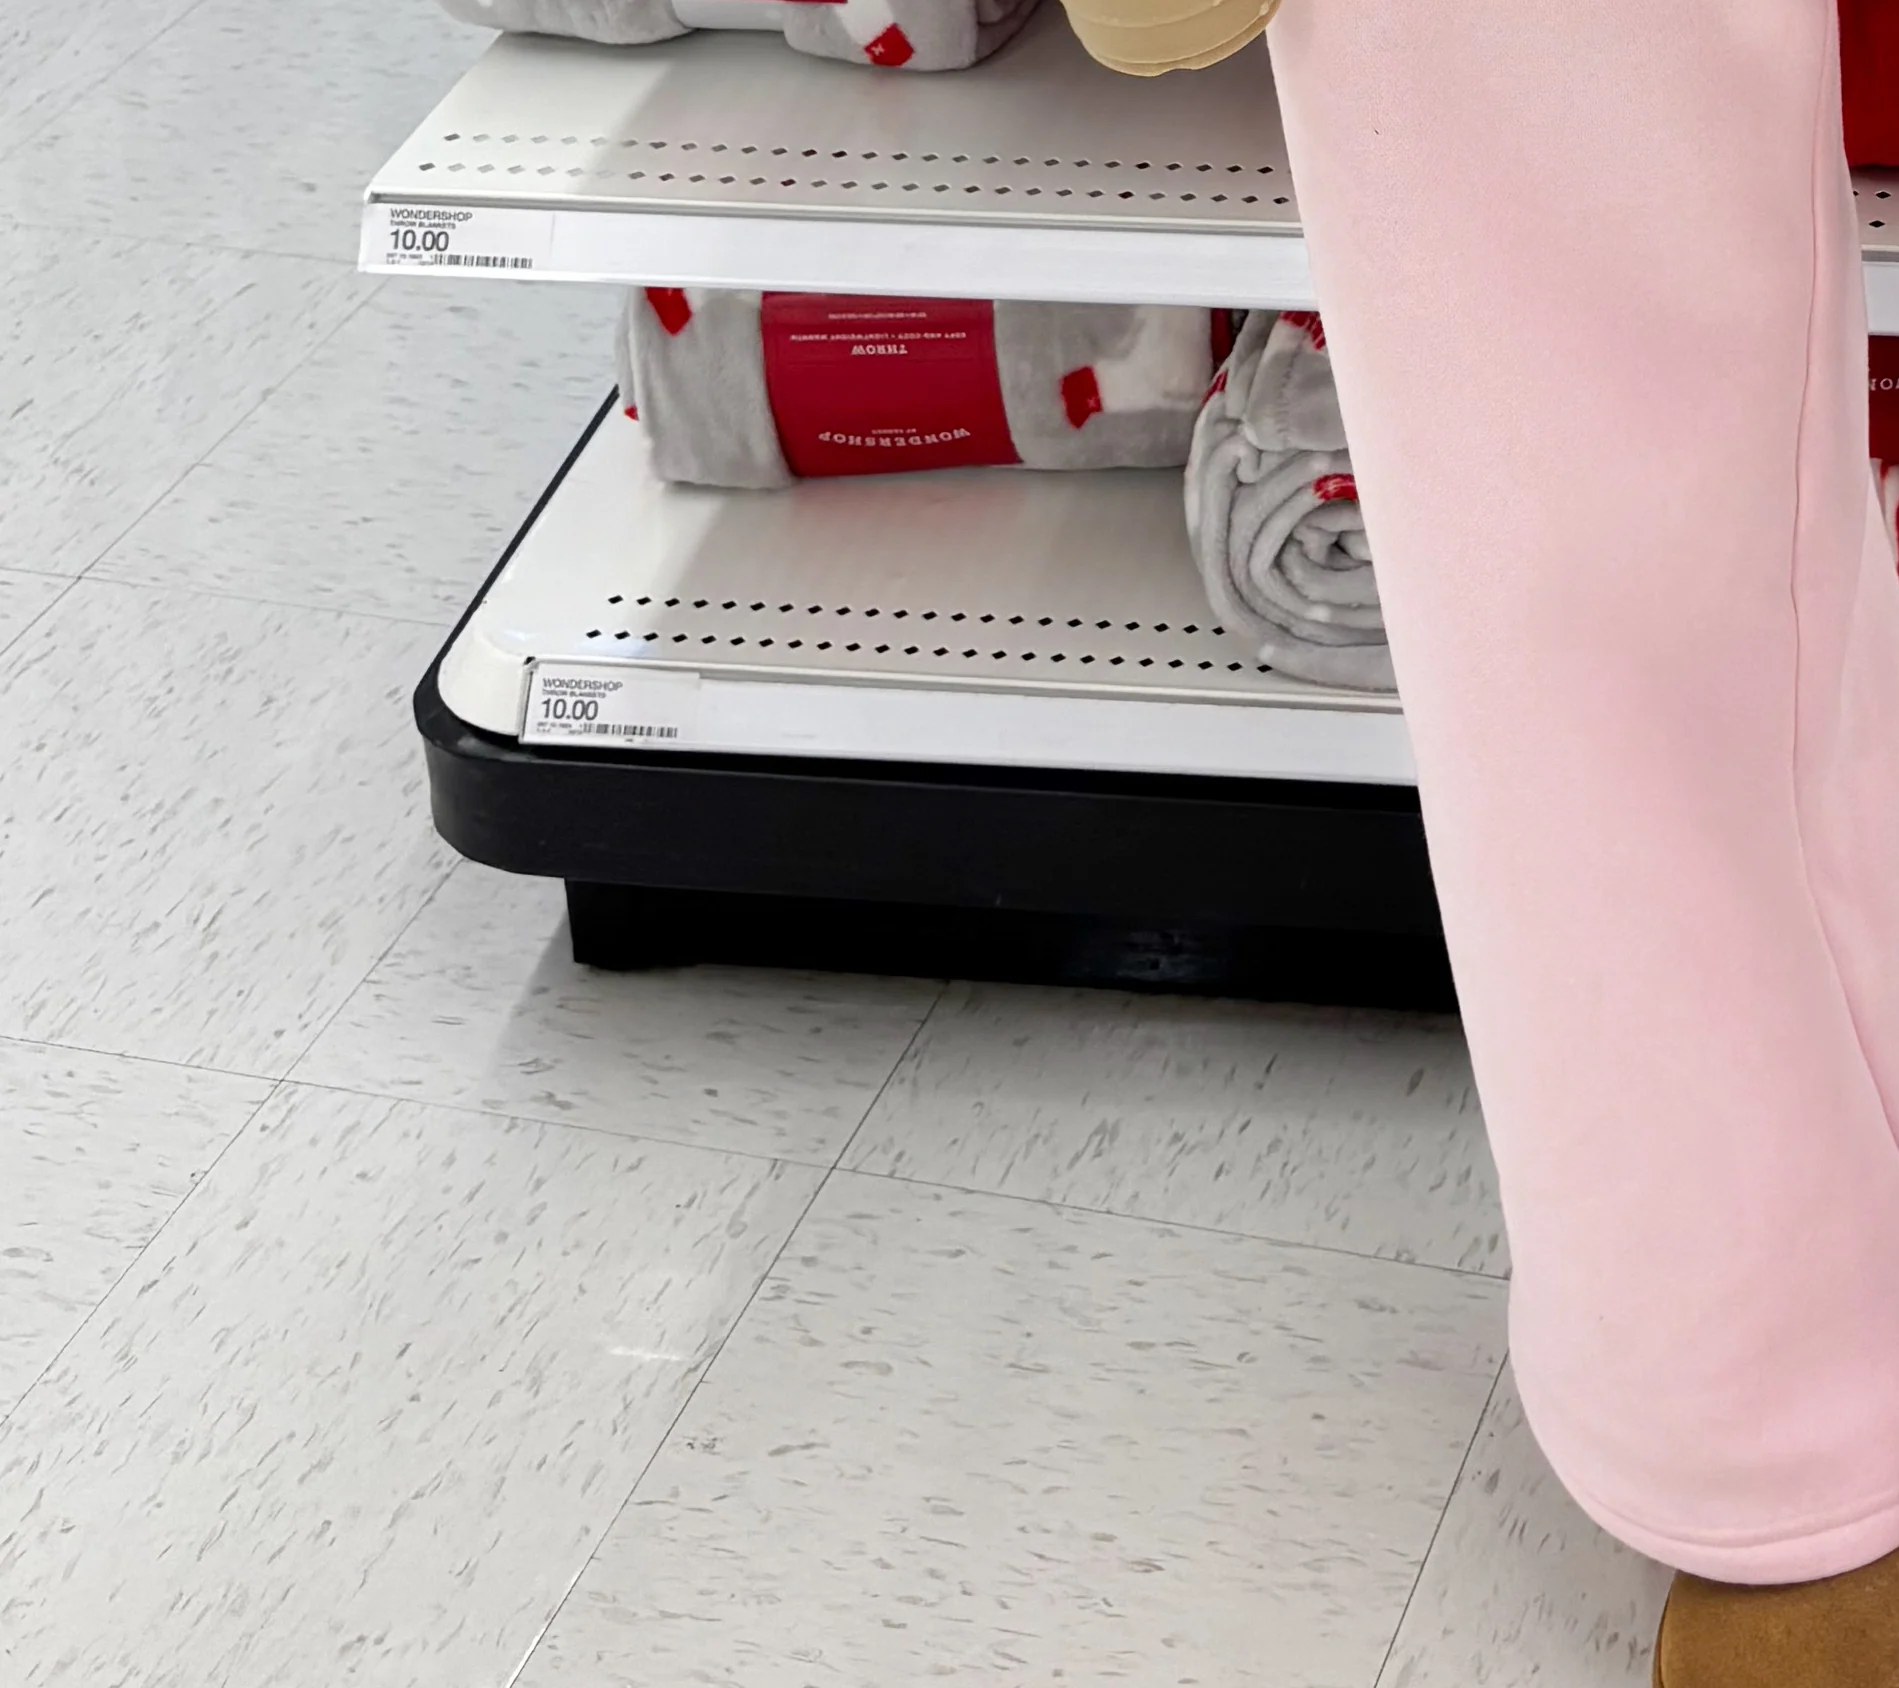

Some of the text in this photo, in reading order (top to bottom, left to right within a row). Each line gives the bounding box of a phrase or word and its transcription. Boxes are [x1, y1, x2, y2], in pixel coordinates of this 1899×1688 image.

[390, 208, 473, 222] WONDERSHOP
[390, 229, 450, 252] 10.00
[850, 344, 908, 356] THROW
[818, 427, 971, 447] WONDERSHOP
[542, 677, 623, 692] WONDERSHOP
[541, 698, 599, 721] 10.00
